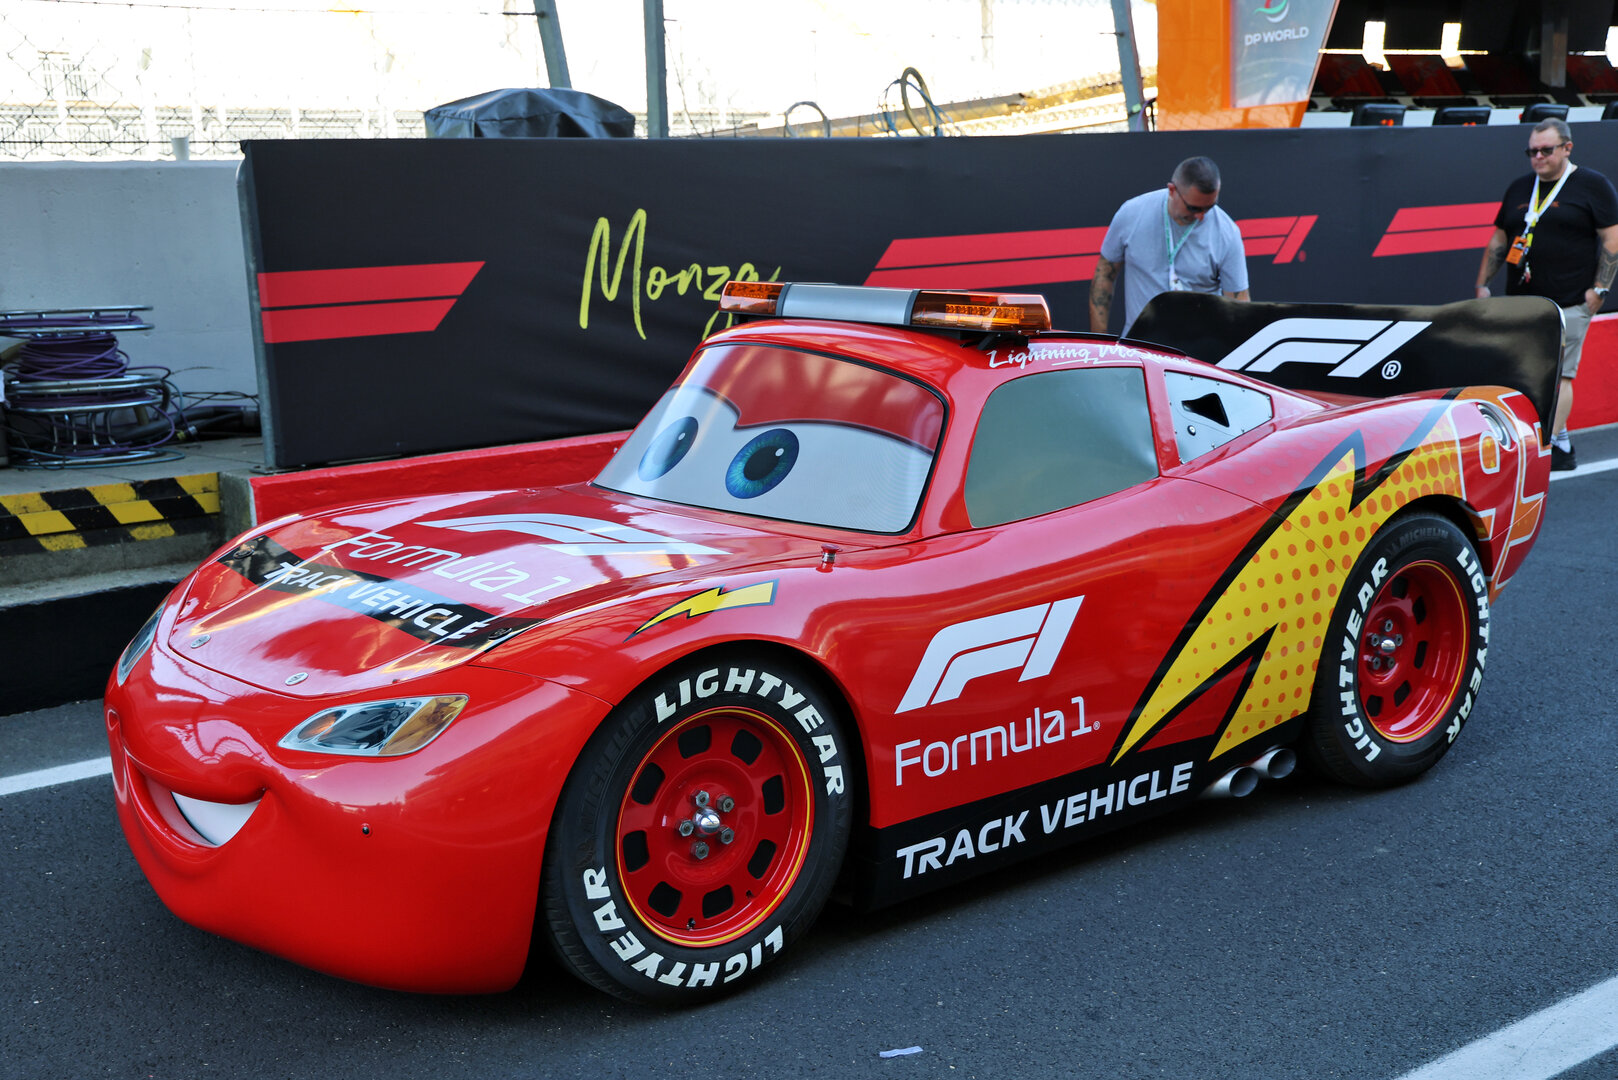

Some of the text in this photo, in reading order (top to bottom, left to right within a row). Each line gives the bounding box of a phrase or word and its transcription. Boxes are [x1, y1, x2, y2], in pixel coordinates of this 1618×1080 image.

[1244, 26, 1309, 46] DP WORLD
[985, 345, 1092, 370] Lightning
[263, 561, 491, 640] TRACK VEHICLE
[321, 532, 531, 592] Formula
[1339, 557, 1388, 763] LIGHTYEAR
[654, 667, 845, 796] LIGHTYEAR
[894, 706, 1066, 786] Formula
[896, 761, 1194, 879] TRACK VEHICLE
[583, 866, 784, 988] LIGHTYEAR
